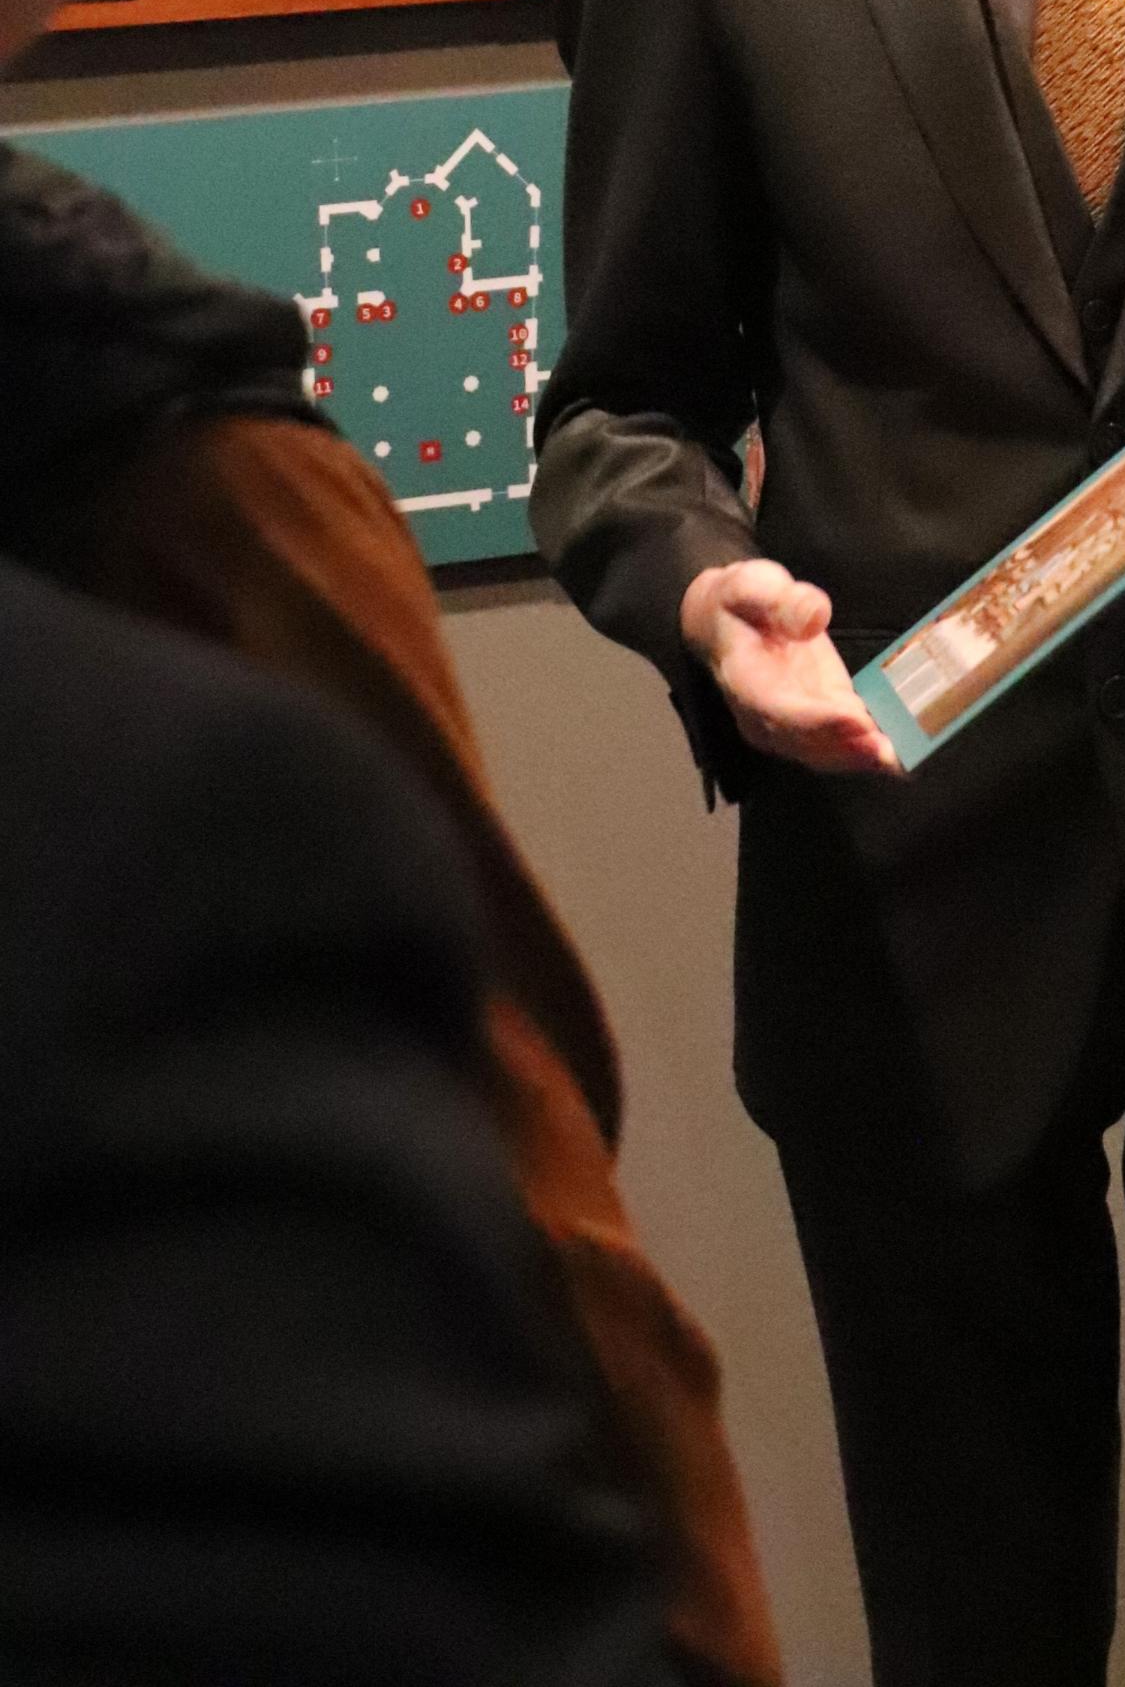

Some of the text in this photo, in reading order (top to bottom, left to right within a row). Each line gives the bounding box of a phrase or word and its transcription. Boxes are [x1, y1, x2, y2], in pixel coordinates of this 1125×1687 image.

[512, 329, 527, 340] 10
[512, 355, 528, 366] 12
[316, 381, 331, 393] 11
[513, 399, 528, 411] 14
